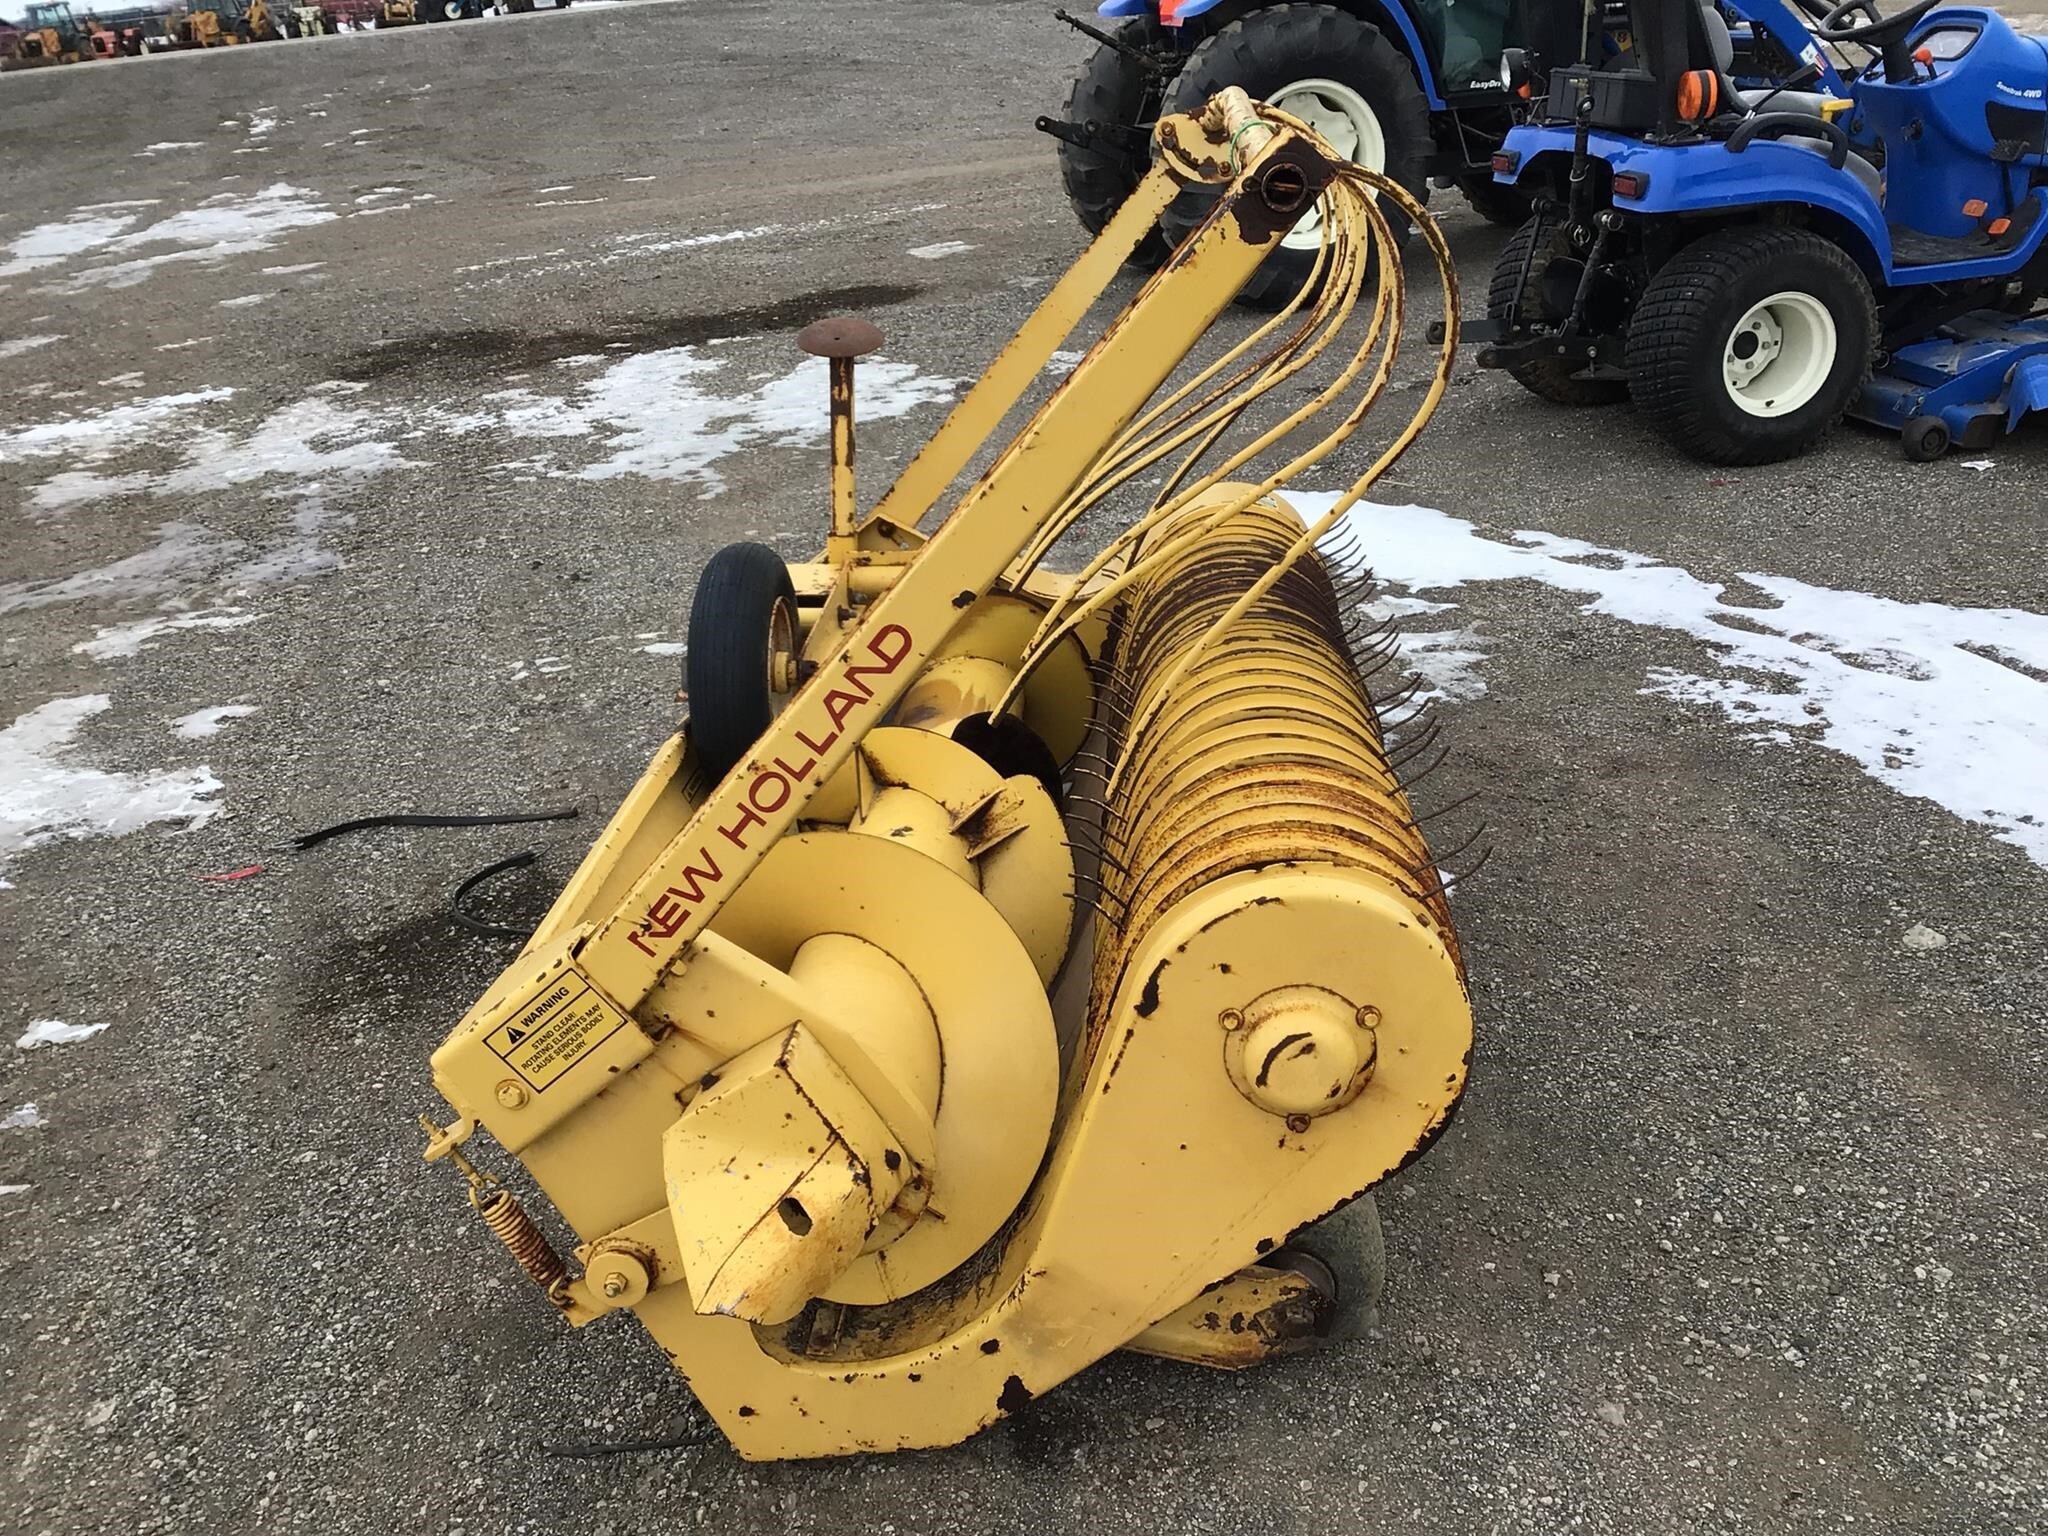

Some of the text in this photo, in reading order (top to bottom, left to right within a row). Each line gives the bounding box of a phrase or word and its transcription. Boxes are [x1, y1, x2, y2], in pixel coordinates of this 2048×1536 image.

[2023, 89, 2042, 98] 4WD
[627, 624, 913, 957] NEW HOLLAND
[520, 986, 570, 1028] WARNING
[521, 1002, 601, 1070] ROTATING ELEMENTS MAY
[531, 1011, 576, 1050] STAND CLEAR!
[531, 1012, 605, 1074] CAUSE SERIOUS BODILY
[561, 1039, 587, 1061] INJURY
